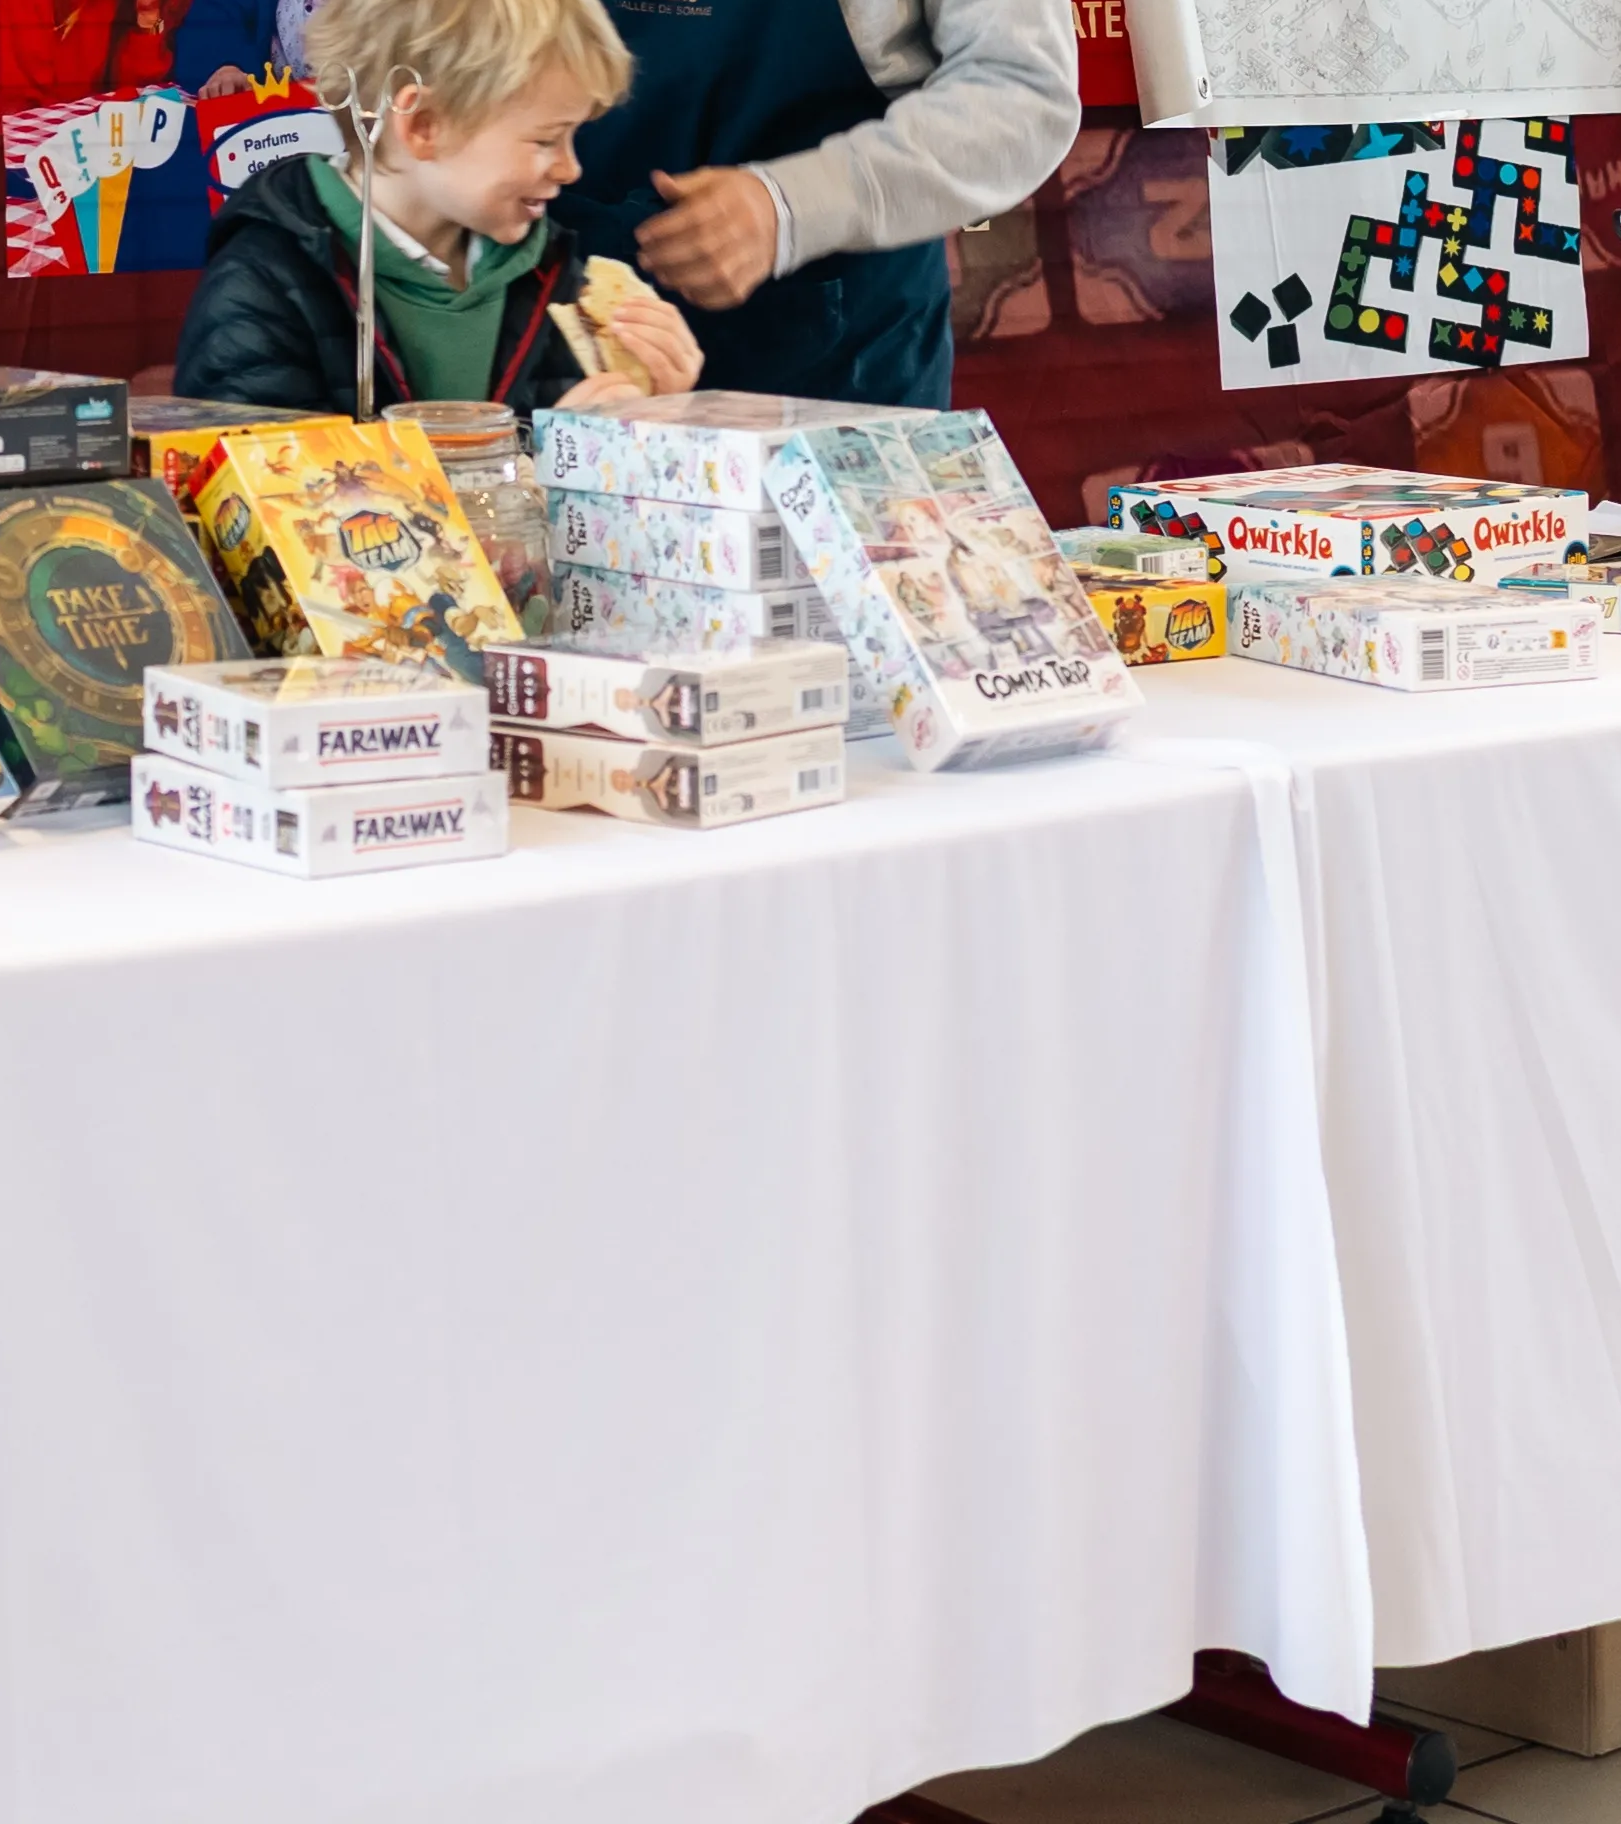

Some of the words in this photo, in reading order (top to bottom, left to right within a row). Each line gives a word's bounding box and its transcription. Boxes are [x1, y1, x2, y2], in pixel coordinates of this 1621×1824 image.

[658, 4, 673, 15] DE
[676, 5, 712, 16] SOMME
[1071, 0, 1124, 38] ATE
[110, 114, 124, 148] H
[151, 113, 167, 143] P
[244, 128, 300, 153] Parfums
[72, 128, 87, 165] E
[342, 513, 403, 550] TAG
[1228, 515, 1334, 562] Qwirkle
[1473, 508, 1567, 552] Qwirkle
[359, 539, 419, 571] TEAM
[45, 582, 128, 622] TAKE
[1170, 602, 1210, 634] TAG
[1603, 596, 1618, 619] 7
[57, 615, 149, 658] TIME
[1170, 624, 1215, 645] TEAM
[318, 723, 442, 758] FARAWAY
[353, 809, 465, 842] FARAWAY
